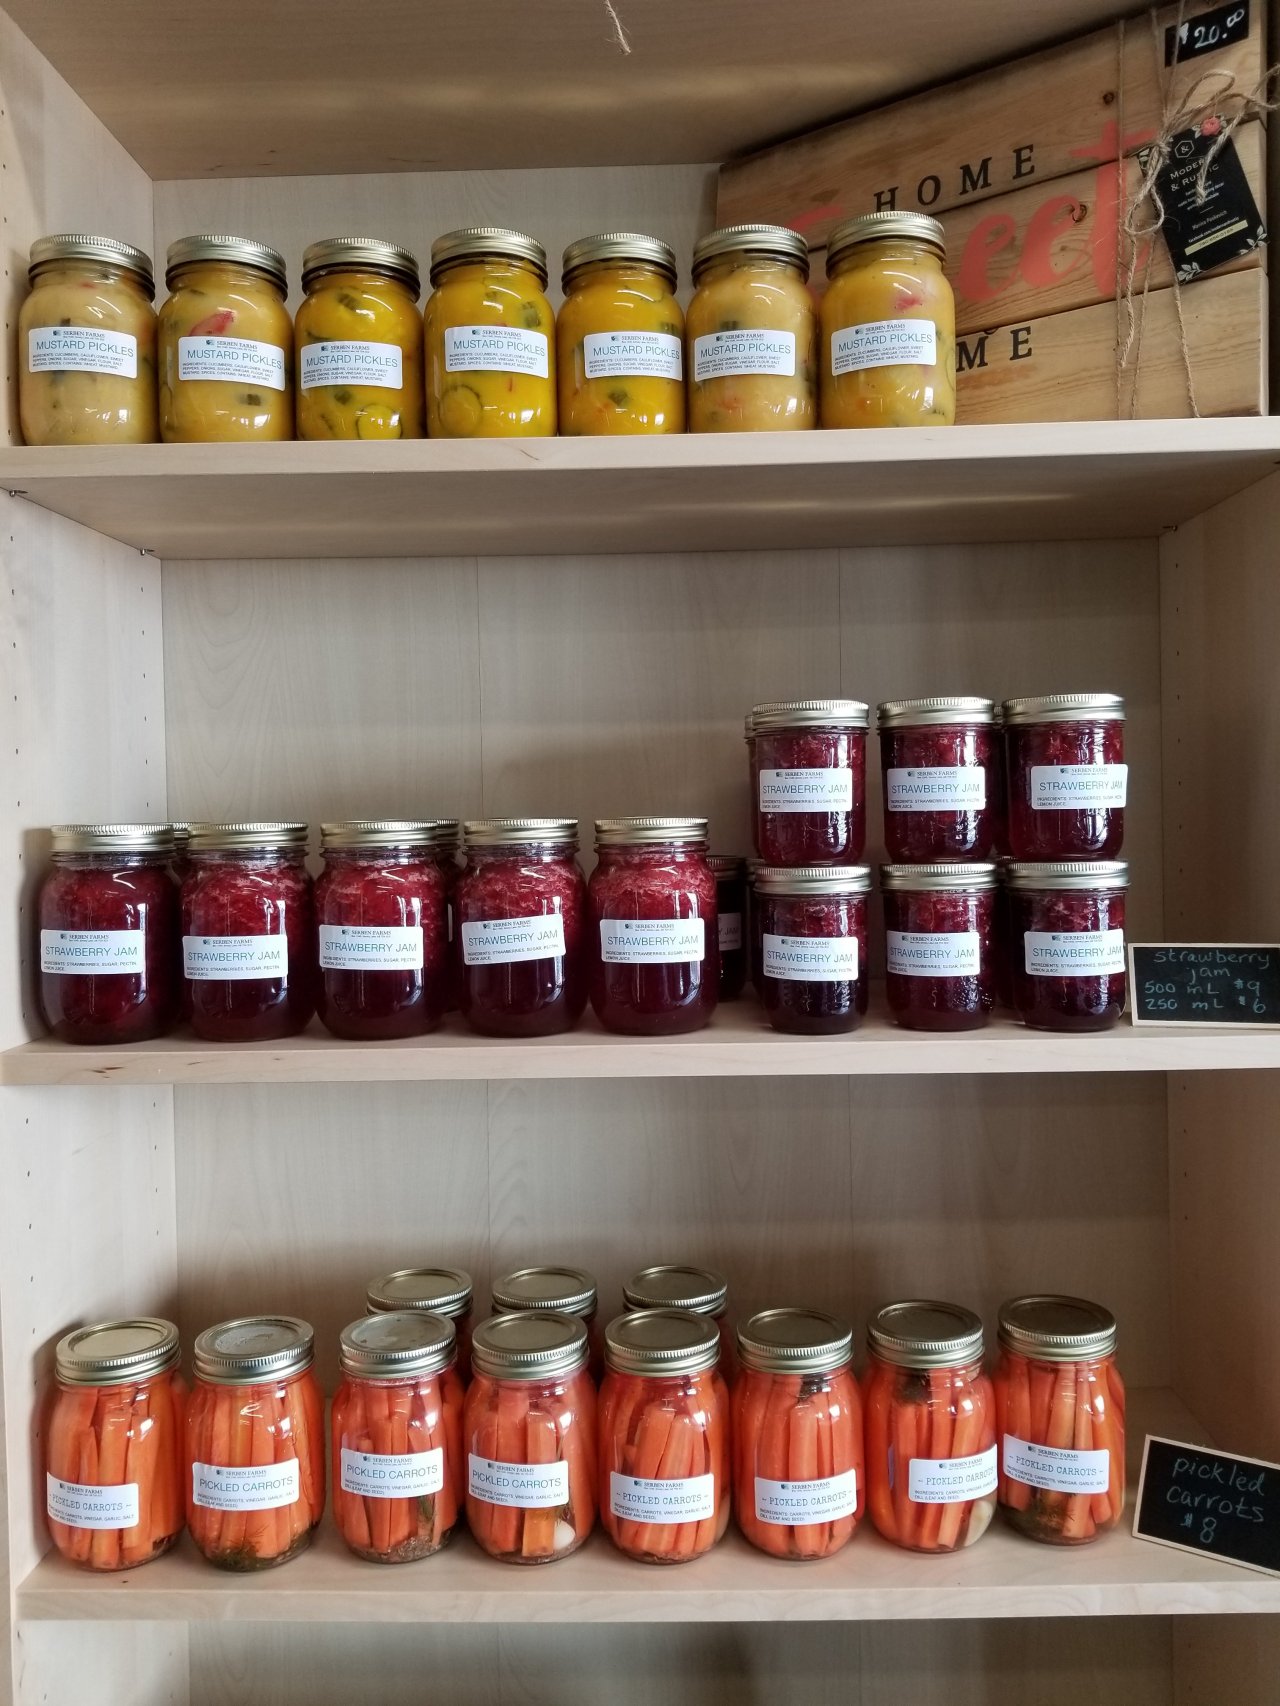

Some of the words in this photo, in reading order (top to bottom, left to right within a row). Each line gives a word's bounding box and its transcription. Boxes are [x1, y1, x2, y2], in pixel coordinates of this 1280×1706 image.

[1170, 158, 1206, 179] MODER
[874, 145, 1035, 212] HOME
[36, 340, 85, 350] MUSTARD
[88, 341, 134, 357] PICKLES
[454, 340, 504, 350] MUSTARD
[507, 342, 545, 357] PICKLES
[700, 343, 746, 358] MUSTARD
[748, 343, 791, 354] PICKLES
[838, 335, 887, 352] MUSTARD
[890, 334, 933, 344] PICKLES
[956, 326, 1032, 372] ME
[187, 349, 239, 360] MUSTARD
[242, 352, 282, 370] PICKLES
[593, 346, 643, 356] MUSTARD
[646, 346, 680, 360] PICKLES
[306, 355, 352, 367] MUSTARD
[355, 355, 398, 367] PICKLES
[762, 784, 826, 794] STRAWBERRY
[828, 784, 847, 793] JAM
[891, 784, 959, 794] STRAWBERRY
[962, 784, 979, 792] JAM
[1040, 781, 1108, 791] STRAWBERRY
[1111, 781, 1122, 790] JAM
[468, 933, 534, 947] STRAWBERRY
[537, 930, 558, 941] JAM
[607, 936, 676, 946] STRAWBERRY
[679, 935, 699, 945] JAM
[45, 946, 111, 957] STRAWBERRY
[114, 946, 137, 956] JAM
[325, 941, 393, 952] STRAWBERRY
[396, 944, 417, 952] JAM
[890, 947, 951, 958] STRAWBERRY
[954, 948, 974, 958] JAM
[1032, 947, 1105, 958] STRAWBERRY
[1107, 945, 1121, 956] JAM
[188, 952, 255, 962] STRAWBERRY
[258, 951, 280, 960] JAM
[767, 950, 831, 962] STRAWBERRY
[834, 954, 852, 962] JAM
[1154, 948, 1270, 969] strawberry
[1186, 967, 1230, 985] jam
[1144, 980, 1176, 994] 500
[1145, 998, 1178, 1010] 250
[347, 1464, 386, 1478] PICKLED
[389, 1465, 438, 1480] CARROTS
[1016, 1456, 1054, 1472] PICKLED
[1057, 1466, 1096, 1476] CARROTS
[200, 1478, 240, 1492] PICKLED
[243, 1476, 293, 1492] CARROTS
[472, 1470, 510, 1487] PICKLED
[512, 1478, 562, 1489] CARROTS
[926, 1476, 963, 1485] PICKLED
[1172, 1458, 1265, 1496] pickled
[623, 1492, 660, 1504] PICKLED
[663, 1495, 702, 1505] CARROTS
[770, 1497, 808, 1507] PICKLED
[811, 1491, 846, 1506] CARROTS
[1166, 1486, 1264, 1522] carrots
[83, 1503, 123, 1512] CARROTS
